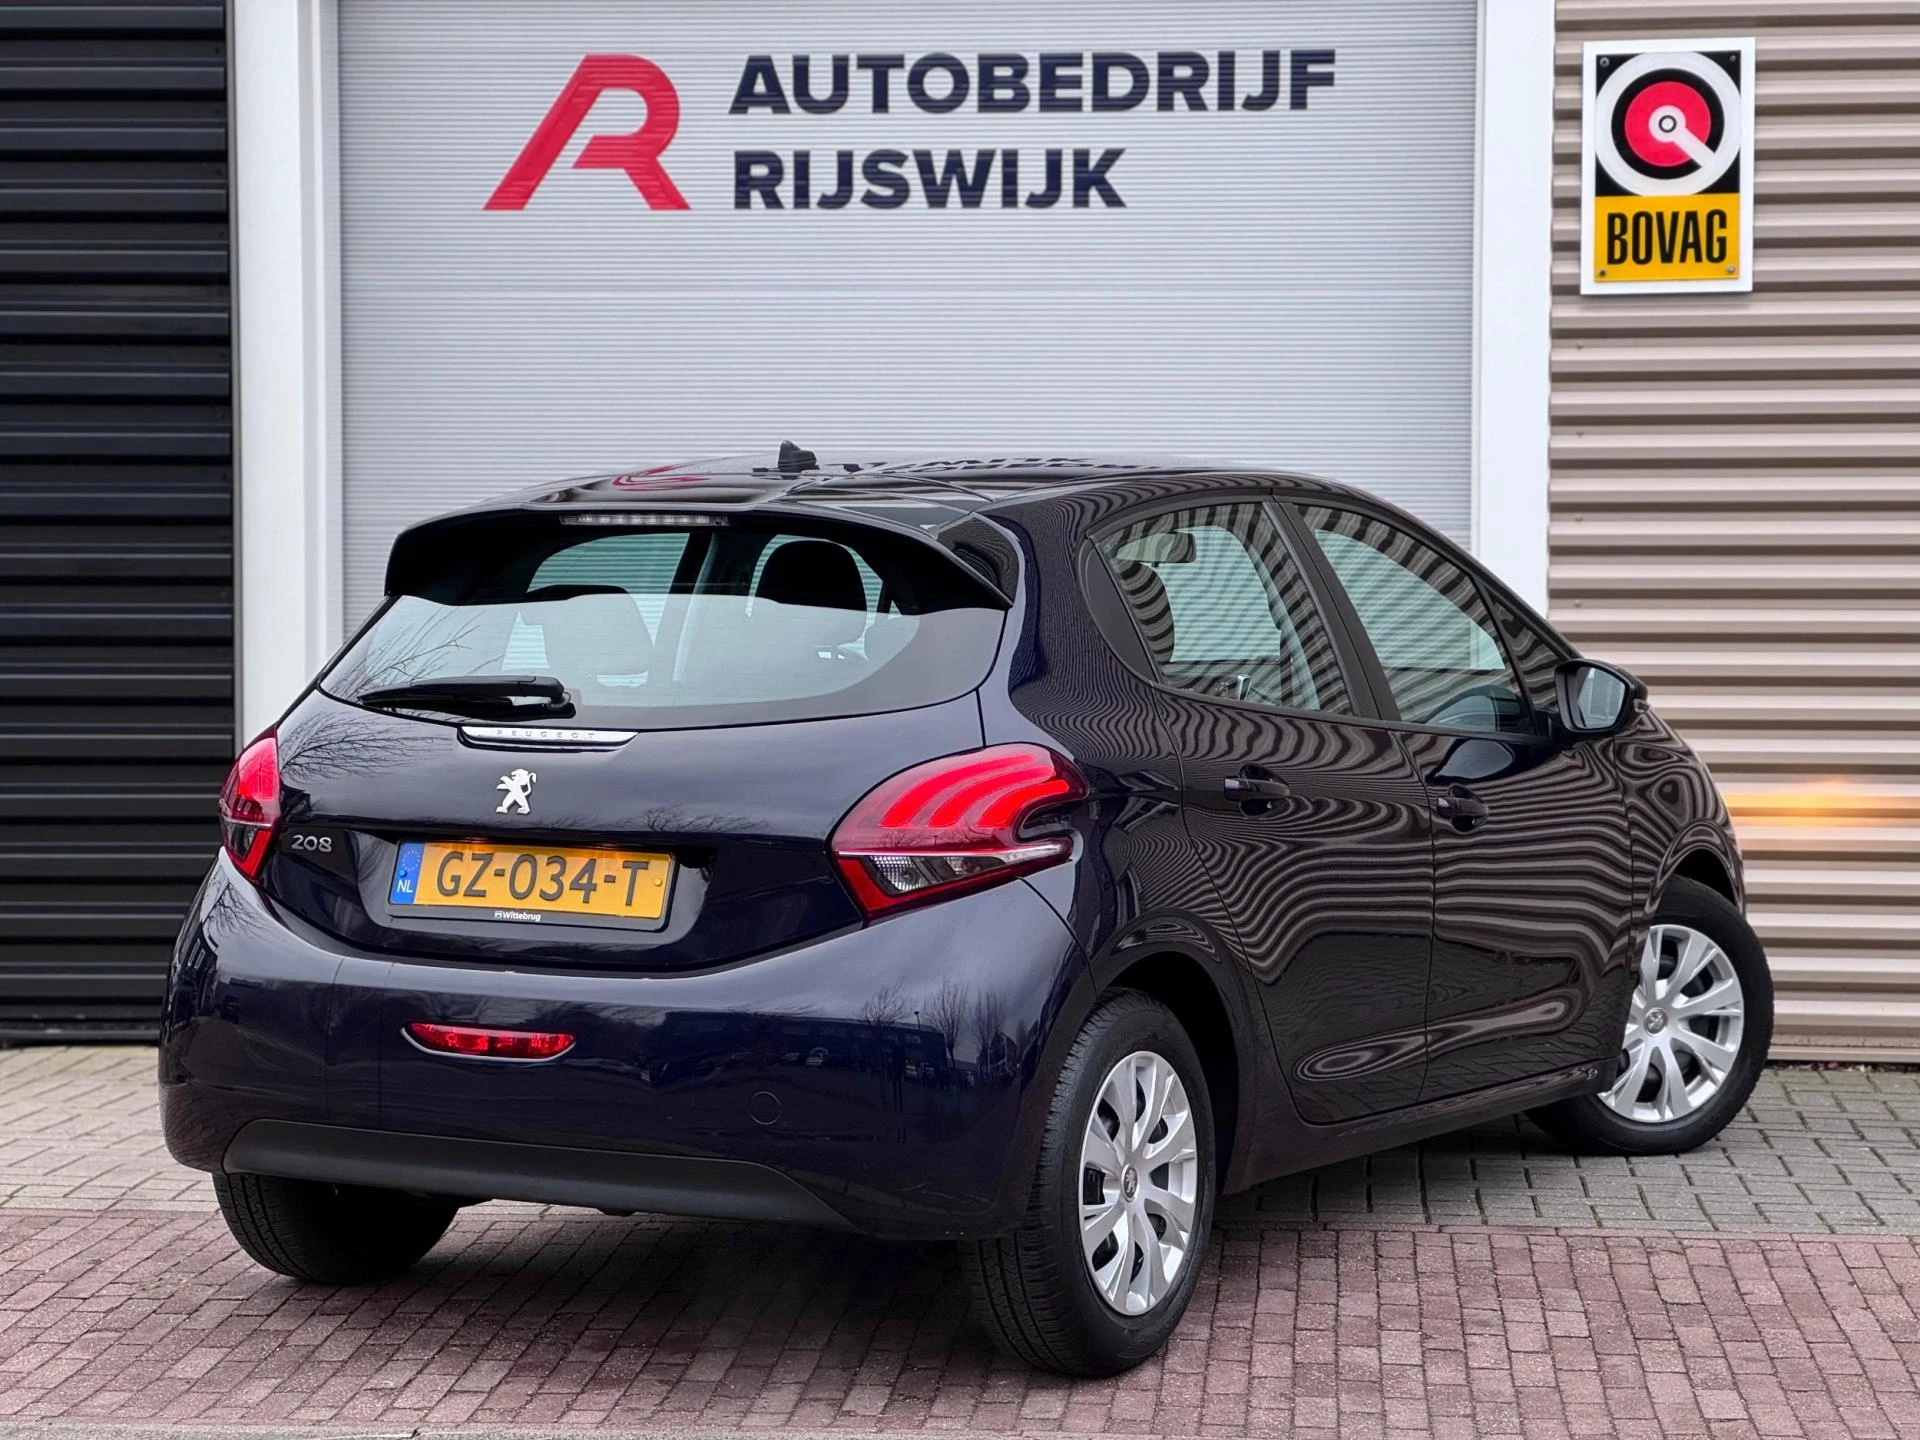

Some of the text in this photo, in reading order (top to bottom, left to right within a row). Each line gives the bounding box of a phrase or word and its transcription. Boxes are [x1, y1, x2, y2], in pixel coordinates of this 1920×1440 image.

[729, 49, 1336, 115] AUTOBEDRIJF
[733, 148, 1127, 210] RIJSWIJK
[1607, 208, 1728, 266] BOVAG
[496, 729, 595, 740] PEUGEOT
[291, 834, 333, 853] 208
[397, 879, 413, 893] NL
[436, 850, 649, 907] GZ-034-T
[502, 910, 541, 922] Wittebrug
